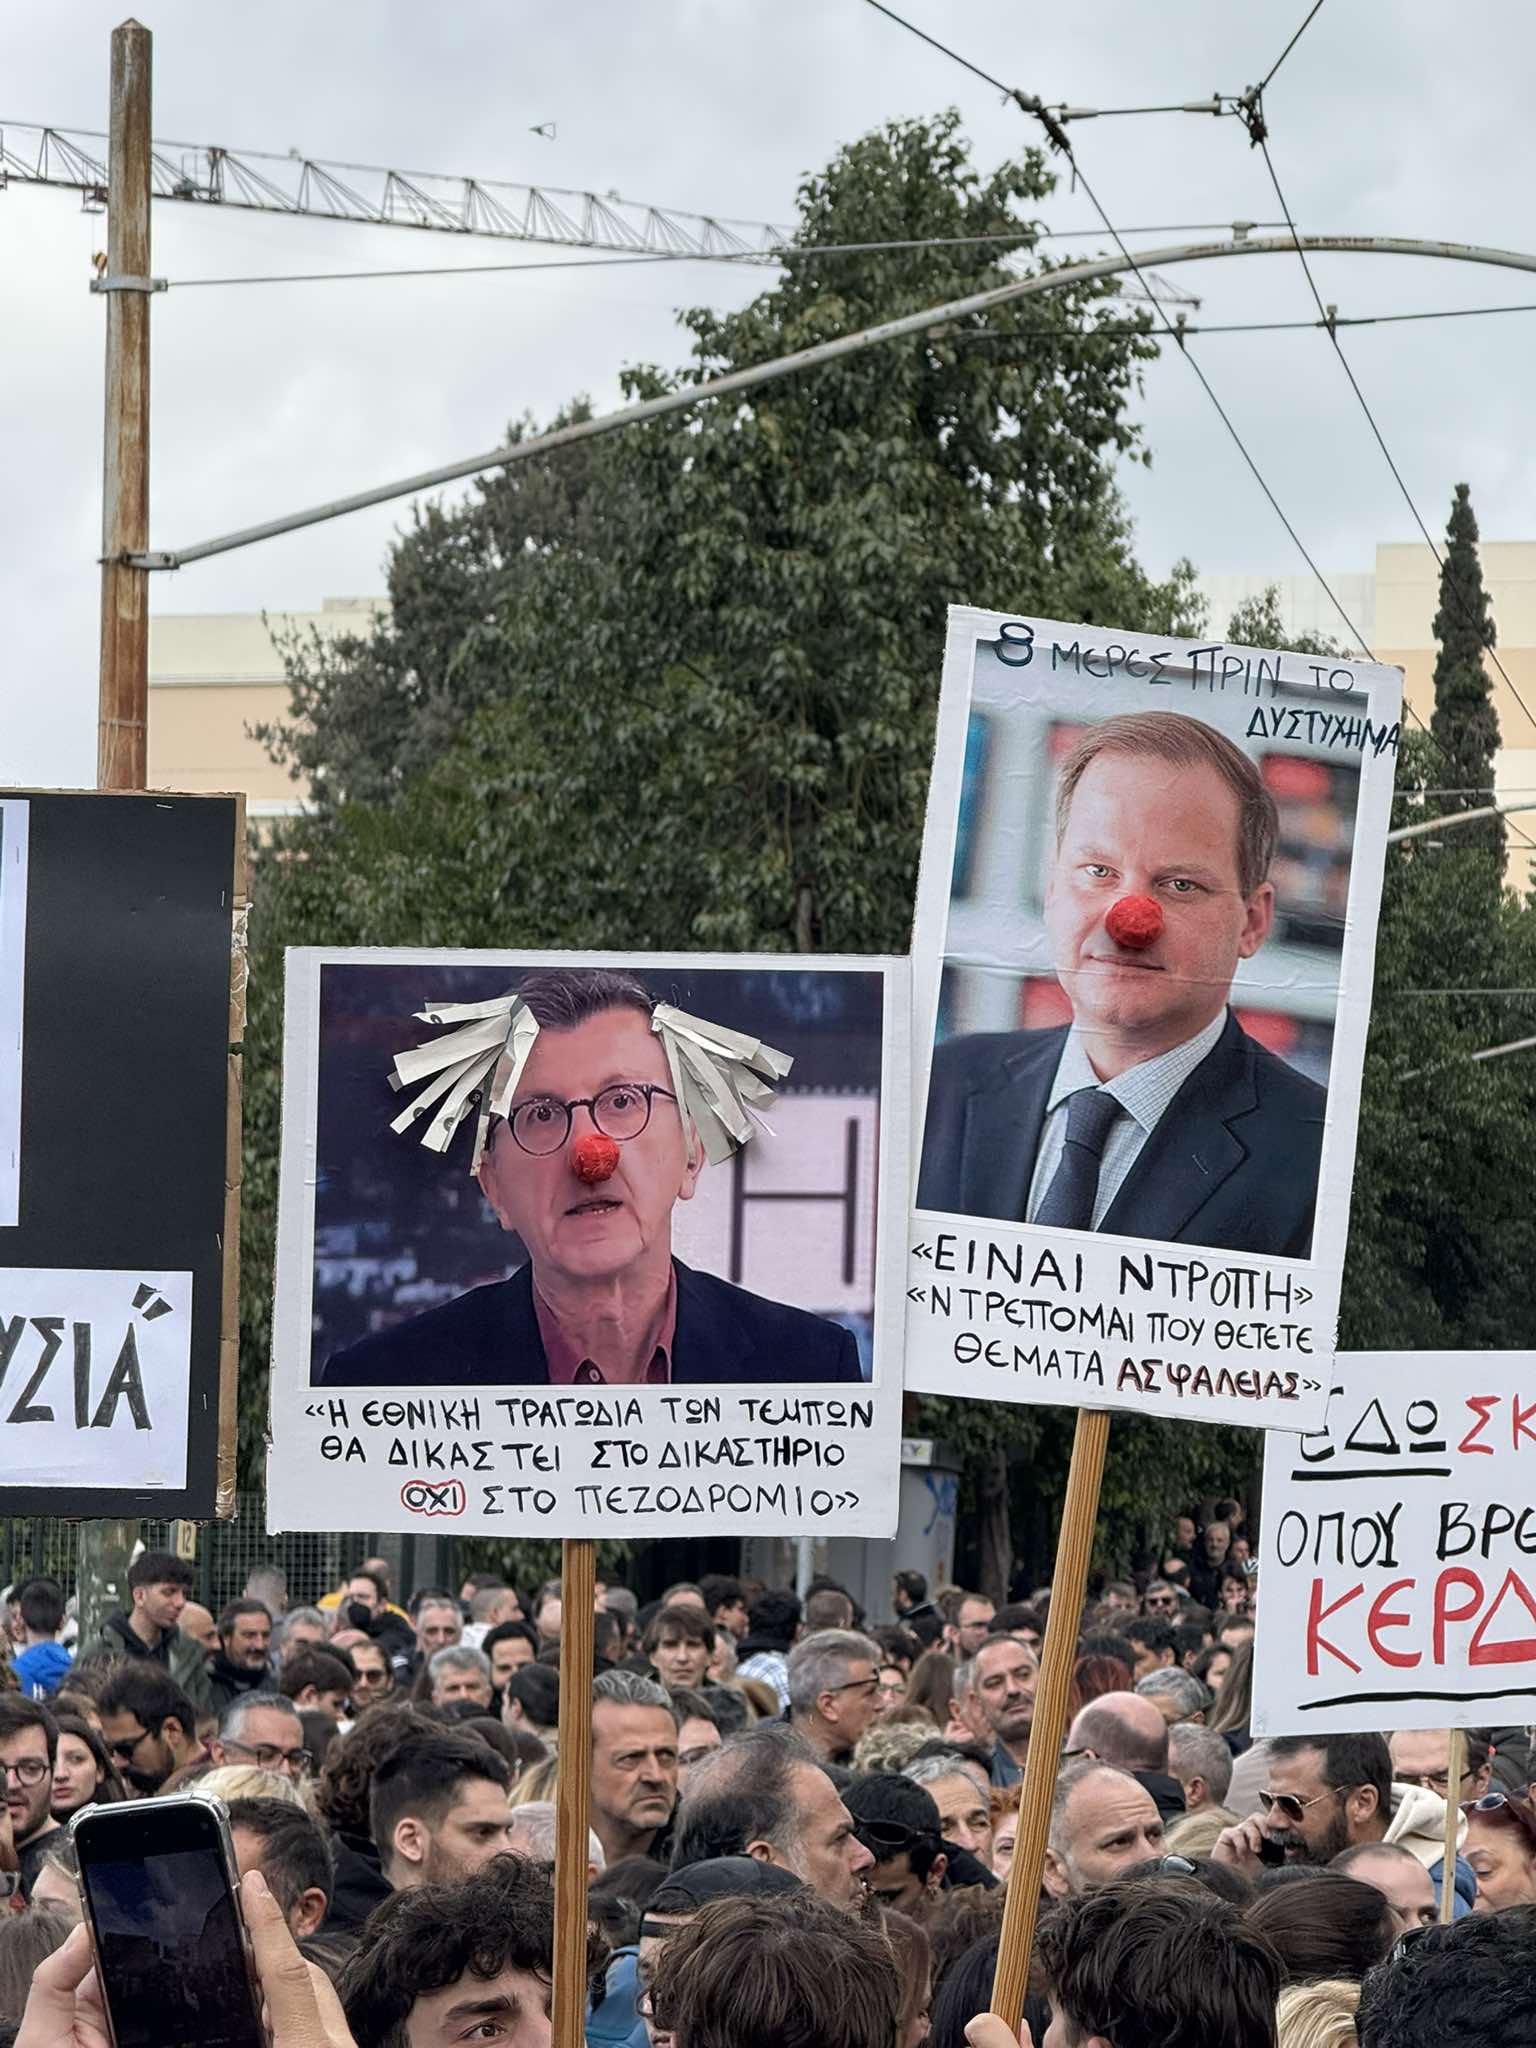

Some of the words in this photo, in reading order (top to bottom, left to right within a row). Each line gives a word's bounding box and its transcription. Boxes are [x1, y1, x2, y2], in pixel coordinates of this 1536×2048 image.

[993, 622, 1034, 666] 8
[1053, 641, 1172, 684] ΜΕΡΕΣ
[1188, 646, 1280, 697] ΠΡΙΝ
[1309, 665, 1354, 694] ΤΟ
[1246, 706, 1400, 758] ΔΥΣΤΥΧΗΜΑ
[912, 1234, 1083, 1293] «ΕΙΝΑΙ
[1120, 1254, 1314, 1314] ΝΤΡΟΠΗ»
[1147, 1313, 1205, 1345] ΠΟΥ
[1215, 1320, 1314, 1353] ΘΕΤΕΤΕ
[954, 1333, 1104, 1386] ΘΕΜΑΤΑ
[1116, 1357, 1322, 1400] ΑΣΦΑΛΕΙΑΣ»
[305, 1399, 348, 1429] «Η
[362, 1398, 480, 1430] ΕΘΝΙΚΗ
[496, 1398, 643, 1429] ΤΡΑΓΩΔΙΑ
[661, 1397, 721, 1424] ΤΩΝ
[321, 1435, 366, 1463] ΘΑ
[590, 1440, 648, 1468] ΣΤΟ
[658, 1436, 845, 1469] ΔΙΚΑΣΤΗΡΙΟ
[405, 1486, 458, 1510] ΟΧΙ
[482, 1486, 556, 1515] ΣΤΟ
[575, 1483, 860, 1516] ΠΕΖΟΔΡΟΜΙΟ»
[1277, 1502, 1403, 1568] ΟΠΟΥ
[1307, 1567, 1536, 1676] ΚΕΡΔ
